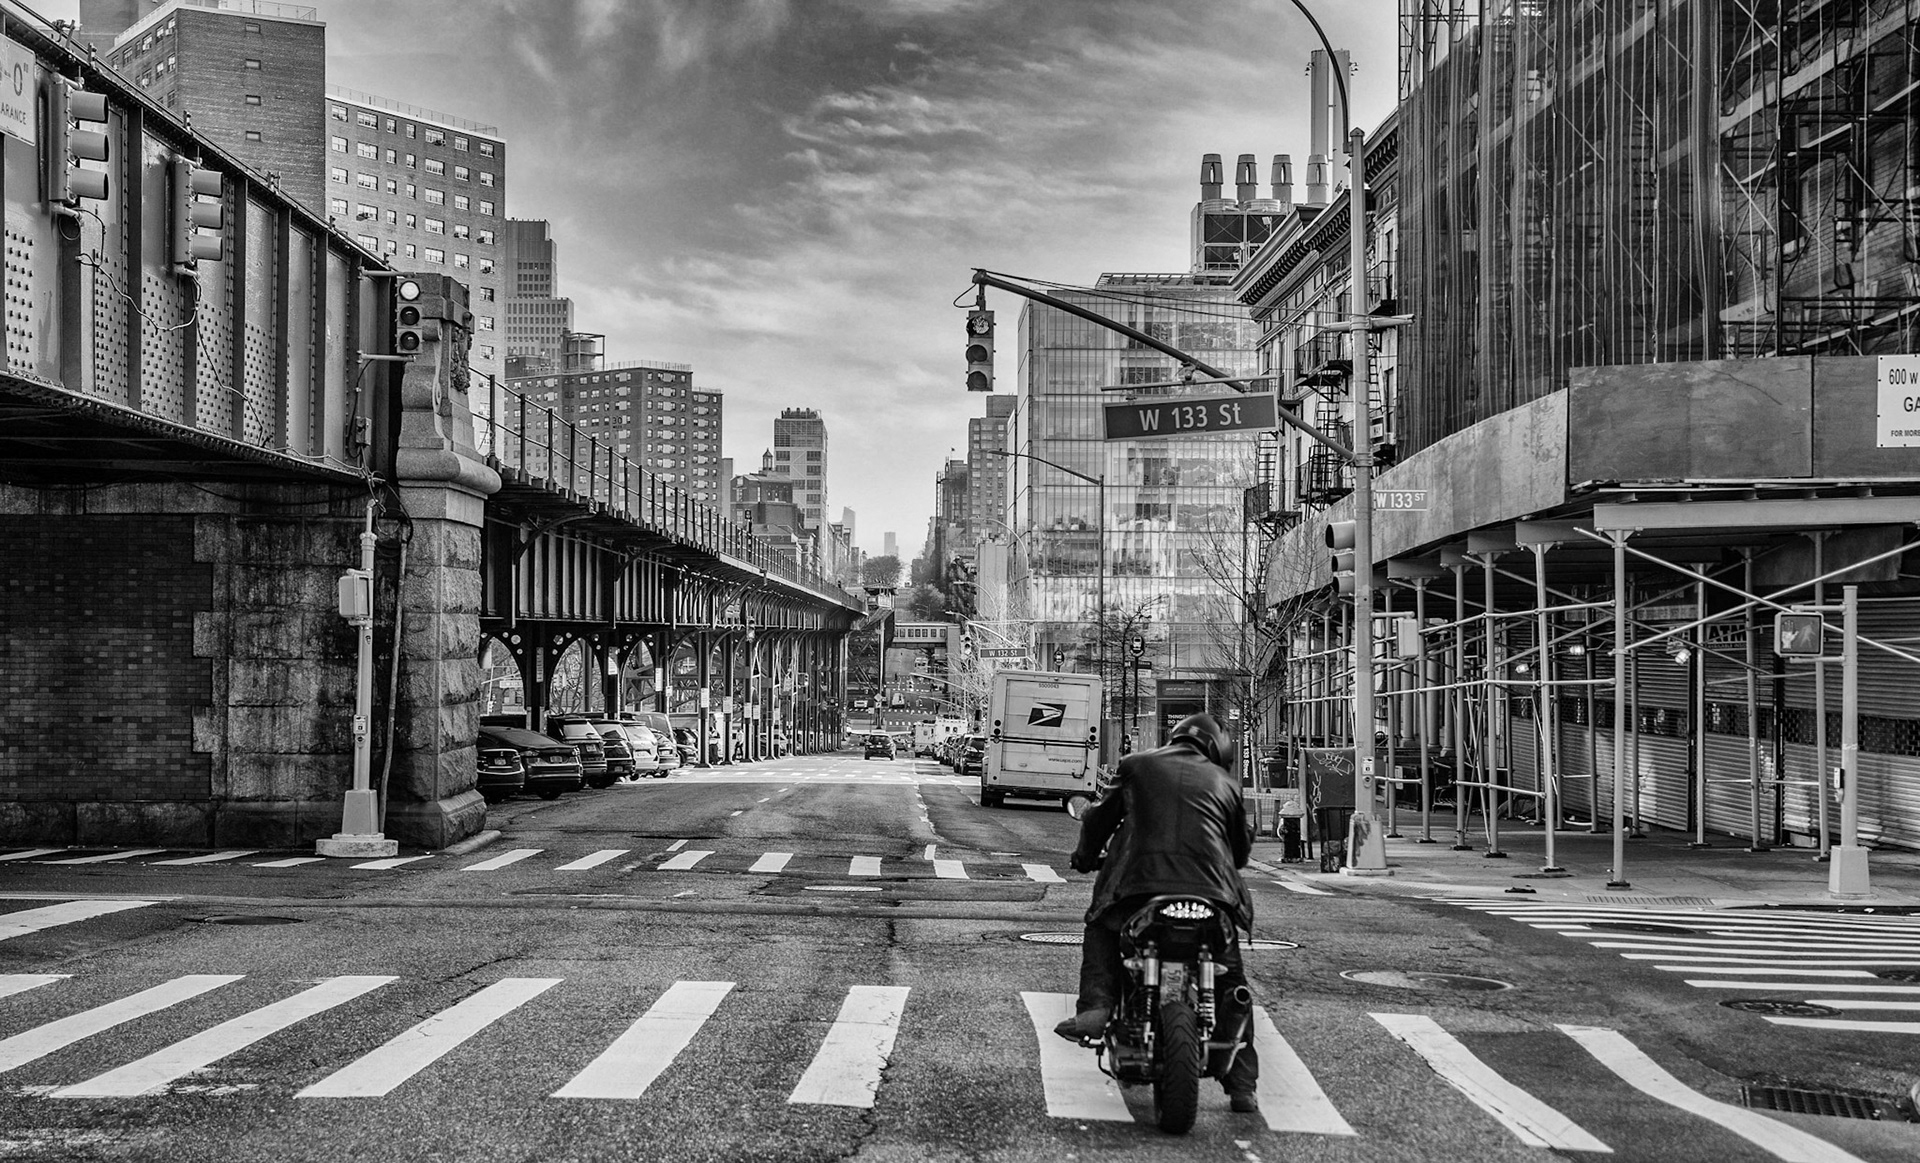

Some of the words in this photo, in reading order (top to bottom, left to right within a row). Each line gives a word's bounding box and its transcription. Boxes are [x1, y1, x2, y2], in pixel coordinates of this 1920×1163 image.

[1889, 368, 1907, 385] 600
[1909, 372, 1919, 385] W
[1138, 408, 1160, 431] W
[1171, 405, 1208, 429] 133
[1219, 402, 1242, 426] St
[1890, 429, 1903, 437] FOR
[1376, 493, 1387, 508] W
[1390, 493, 1413, 508] 133
[1415, 493, 1425, 501] ST
[1708, 624, 1746, 642] ATM
[988, 649, 996, 657] W
[997, 649, 1009, 657] 132
[1010, 649, 1018, 657] St
